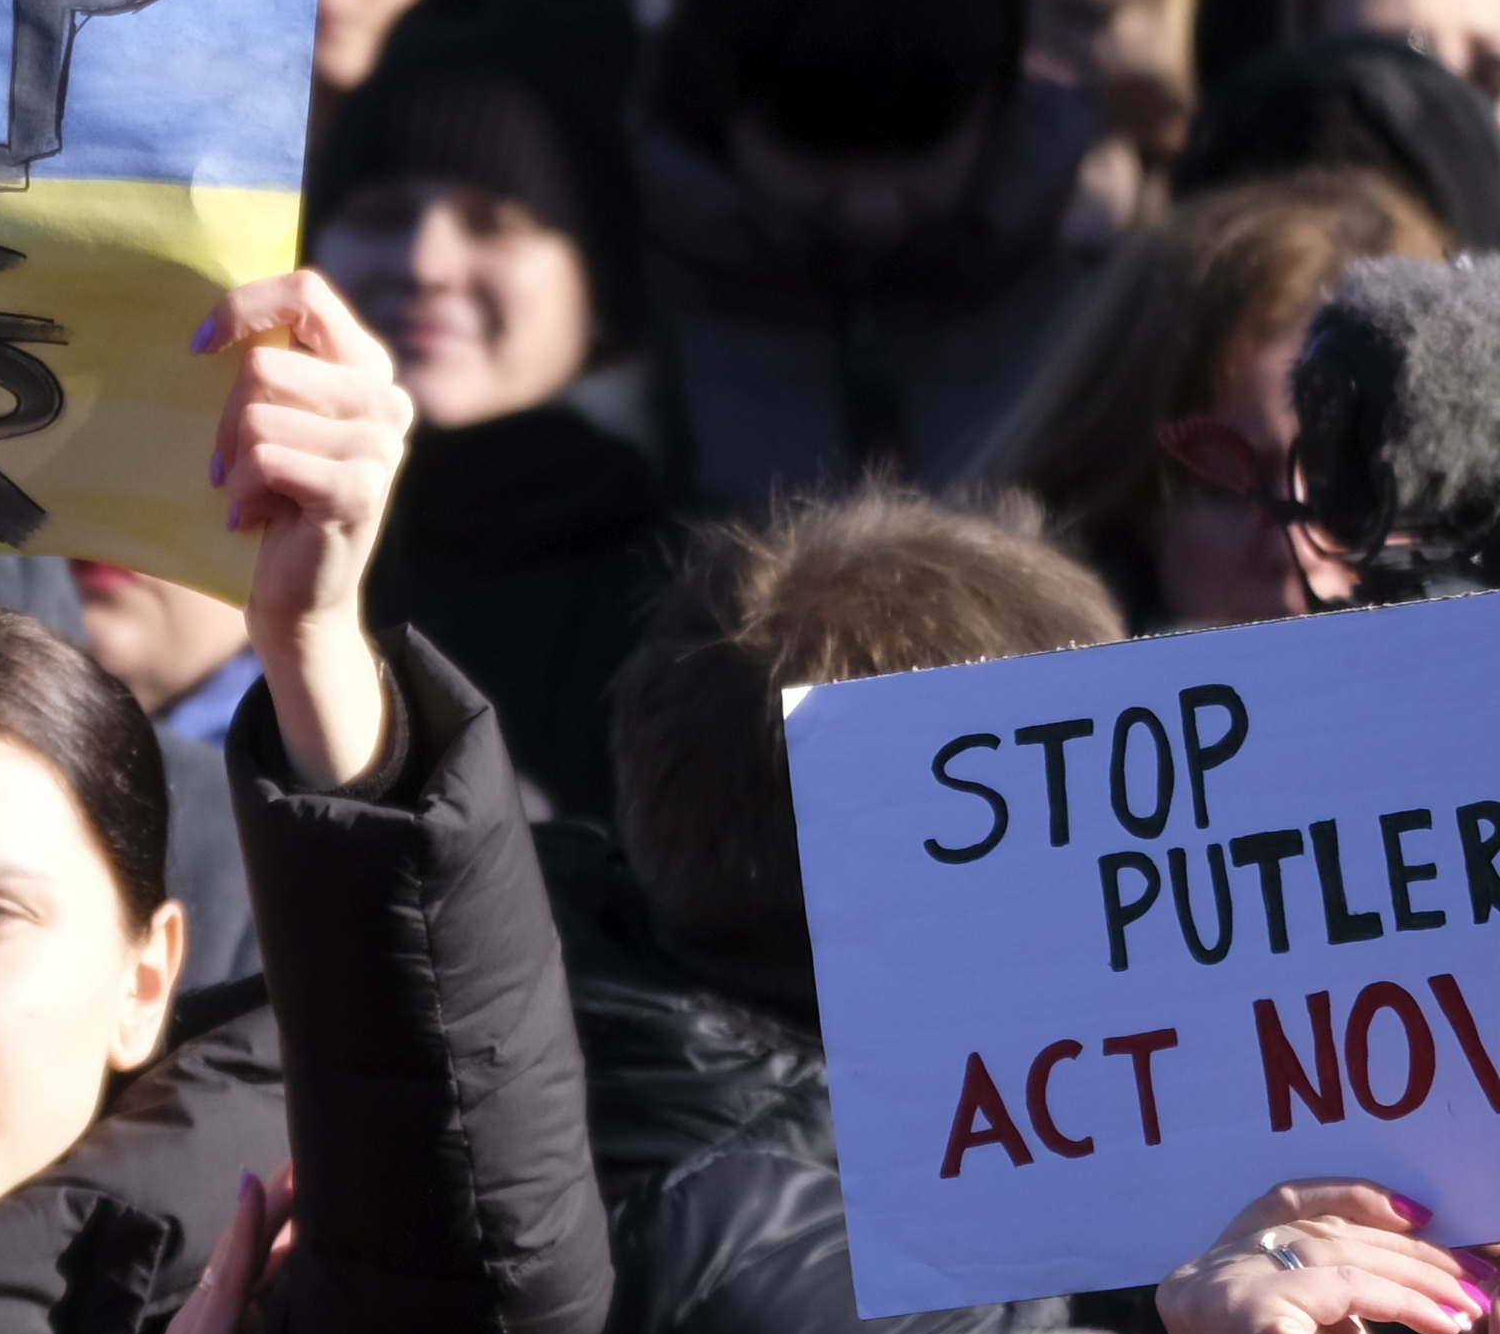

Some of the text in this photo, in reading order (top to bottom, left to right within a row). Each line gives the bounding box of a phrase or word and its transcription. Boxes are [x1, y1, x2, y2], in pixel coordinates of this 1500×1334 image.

[923, 683, 1250, 865] STOP
[1097, 799, 1500, 973] PUTLER
[939, 1027, 1179, 1180] ACT
